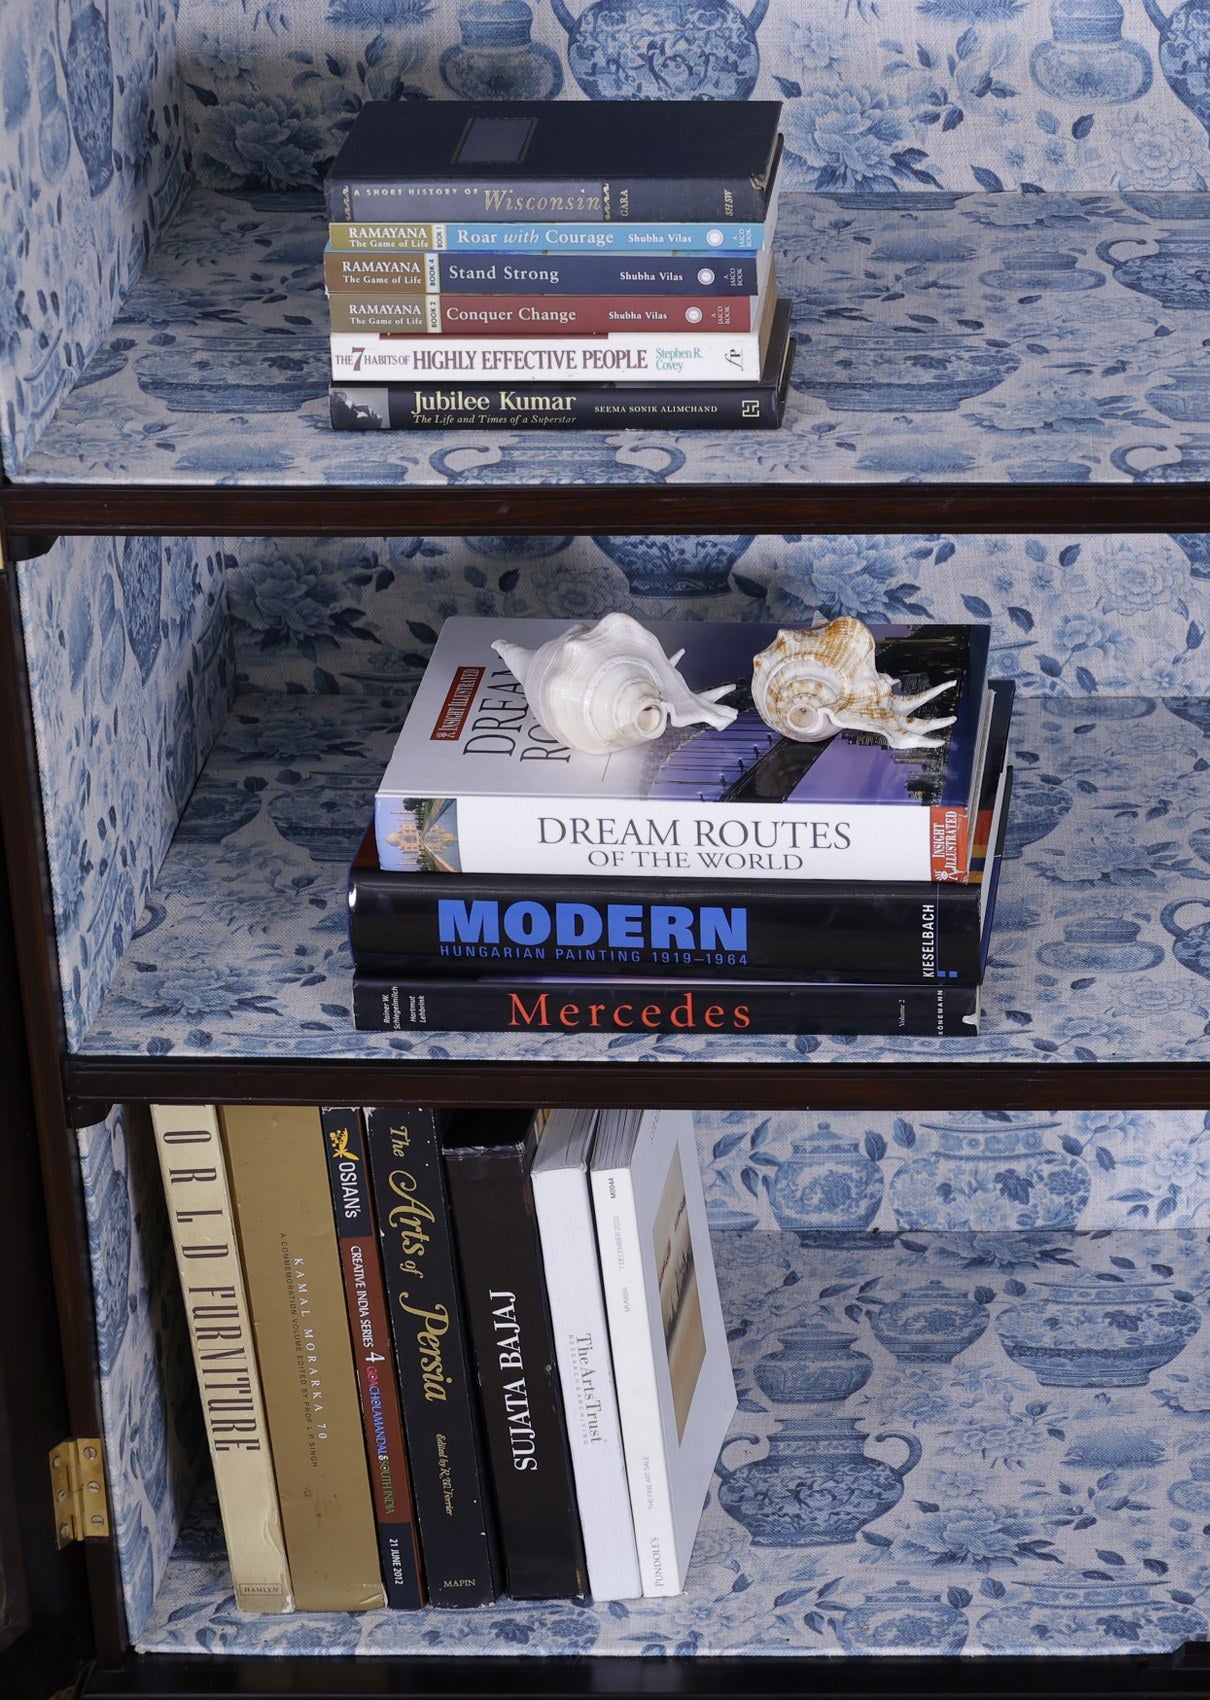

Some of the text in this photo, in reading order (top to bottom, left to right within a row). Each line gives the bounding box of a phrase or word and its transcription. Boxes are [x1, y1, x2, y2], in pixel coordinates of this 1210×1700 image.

[354, 188, 601, 211] A SHORT HISTORY OF Wisconsin
[619, 189, 629, 217] GARA
[349, 227, 428, 239] RAMAYANA
[457, 229, 614, 247] Roar with Courage
[628, 233, 692, 243] Shubha Vilas
[342, 261, 421, 273] RAMAYANA
[449, 265, 559, 284] Stand Strong
[619, 271, 684, 281] Shubha Vilas
[342, 275, 422, 284] The Game of Life
[349, 304, 421, 315] RAMAYANA
[446, 307, 576, 326] Conquer Change
[608, 311, 668, 320] Shubha Vilas
[350, 317, 423, 325] The Game of Life
[335, 346, 648, 372] THE 7 HABITS OF HIGHLY EFFECTIVE PEOPLE
[655, 347, 692, 361] Stephen
[655, 359, 684, 373] Covey
[411, 391, 577, 414] Jubilee Kumar
[594, 405, 718, 413] SEEMA SONIK ALIMCHAND
[413, 414, 432, 424] The
[434, 414, 454, 425] Life
[457, 414, 476, 424] and
[478, 414, 507, 424] Times
[510, 414, 522, 425] of
[531, 414, 577, 425] Superstar
[537, 817, 851, 850] DREAM ROUTES
[932, 822, 945, 858] INSIGHT
[944, 810, 958, 869] ILLUSTRATED
[588, 850, 803, 871] OF THE WORLD
[438, 899, 748, 952] MODERN
[922, 903, 935, 978] KIESELBACH
[440, 944, 546, 959] HUNGARIAN
[555, 947, 642, 963] PAINTING
[508, 992, 751, 1028] Mercedes
[388, 1125, 453, 1402] The Arts of Persia
[163, 1129, 261, 1452] ORLD FURNITURE
[350, 1245, 386, 1363] CREATIVE INDIA SERIES 4
[294, 1257, 328, 1440] KAMAL MORARKA 70
[489, 1289, 538, 1471] SUJATA BAJAJ
[389, 1538, 404, 1585] 21 JUNE 2012
[443, 1578, 476, 1588] MAPIN
